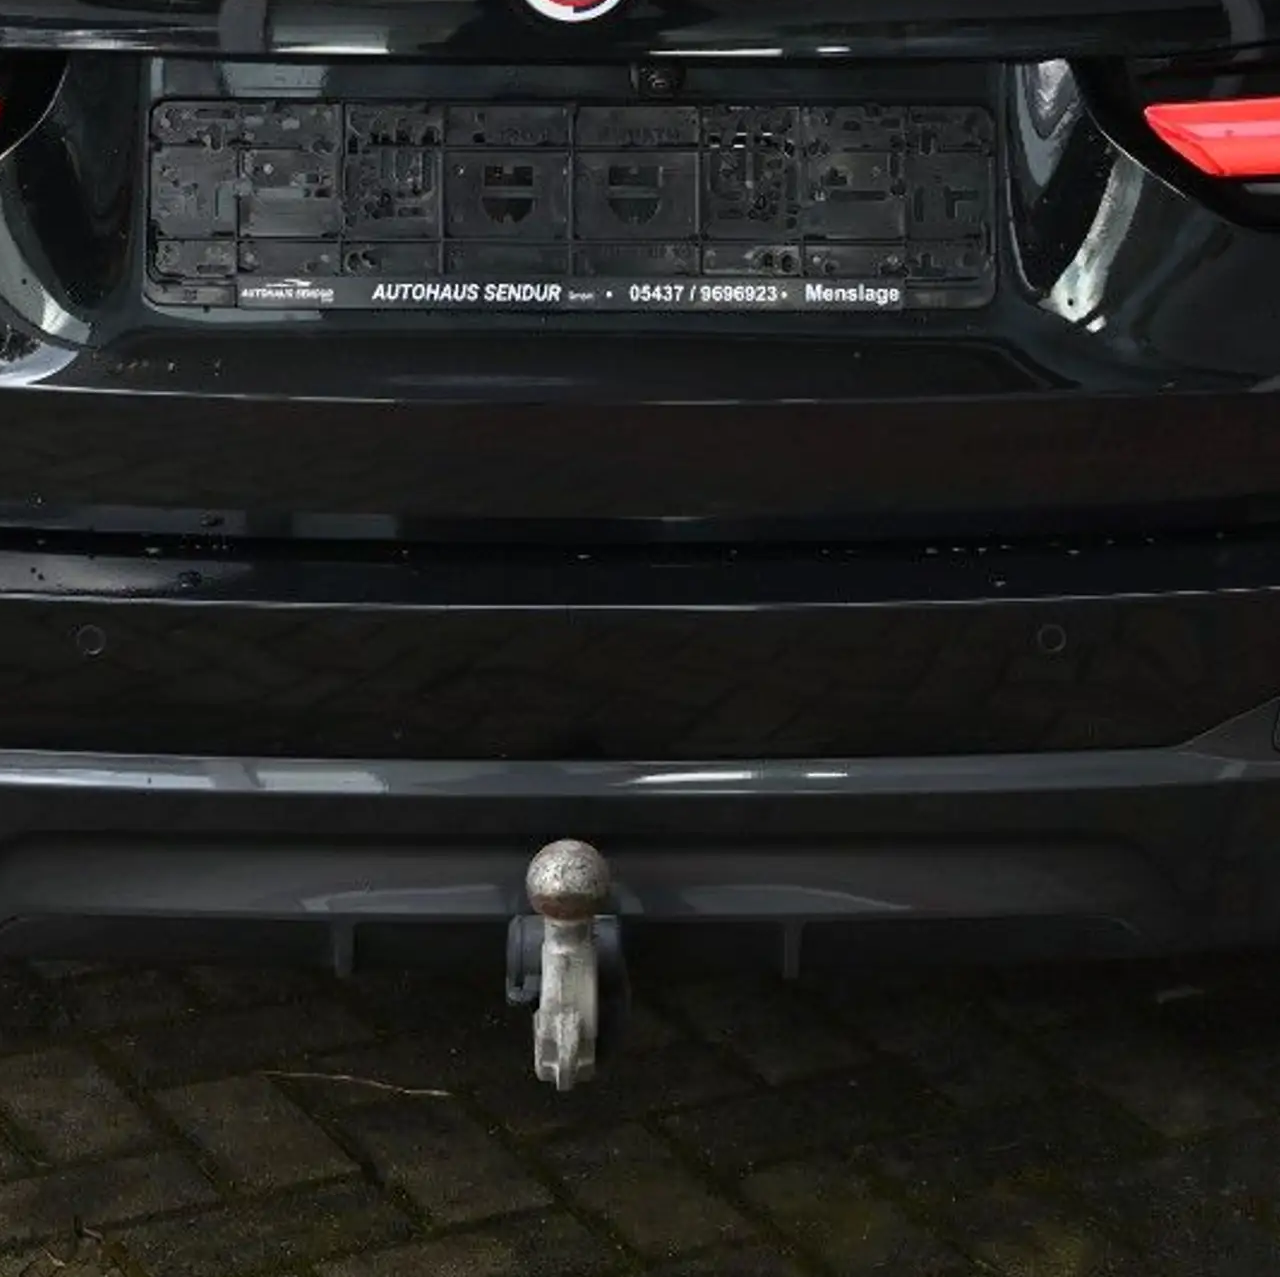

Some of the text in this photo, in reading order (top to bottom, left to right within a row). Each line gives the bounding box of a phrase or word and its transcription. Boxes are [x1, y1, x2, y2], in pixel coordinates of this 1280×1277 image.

[372, 283, 479, 302] AUTOHAUS
[483, 283, 562, 302] SENDUR
[628, 283, 685, 302] 05437
[699, 283, 779, 303] 9696923
[804, 283, 901, 307] Menslage
